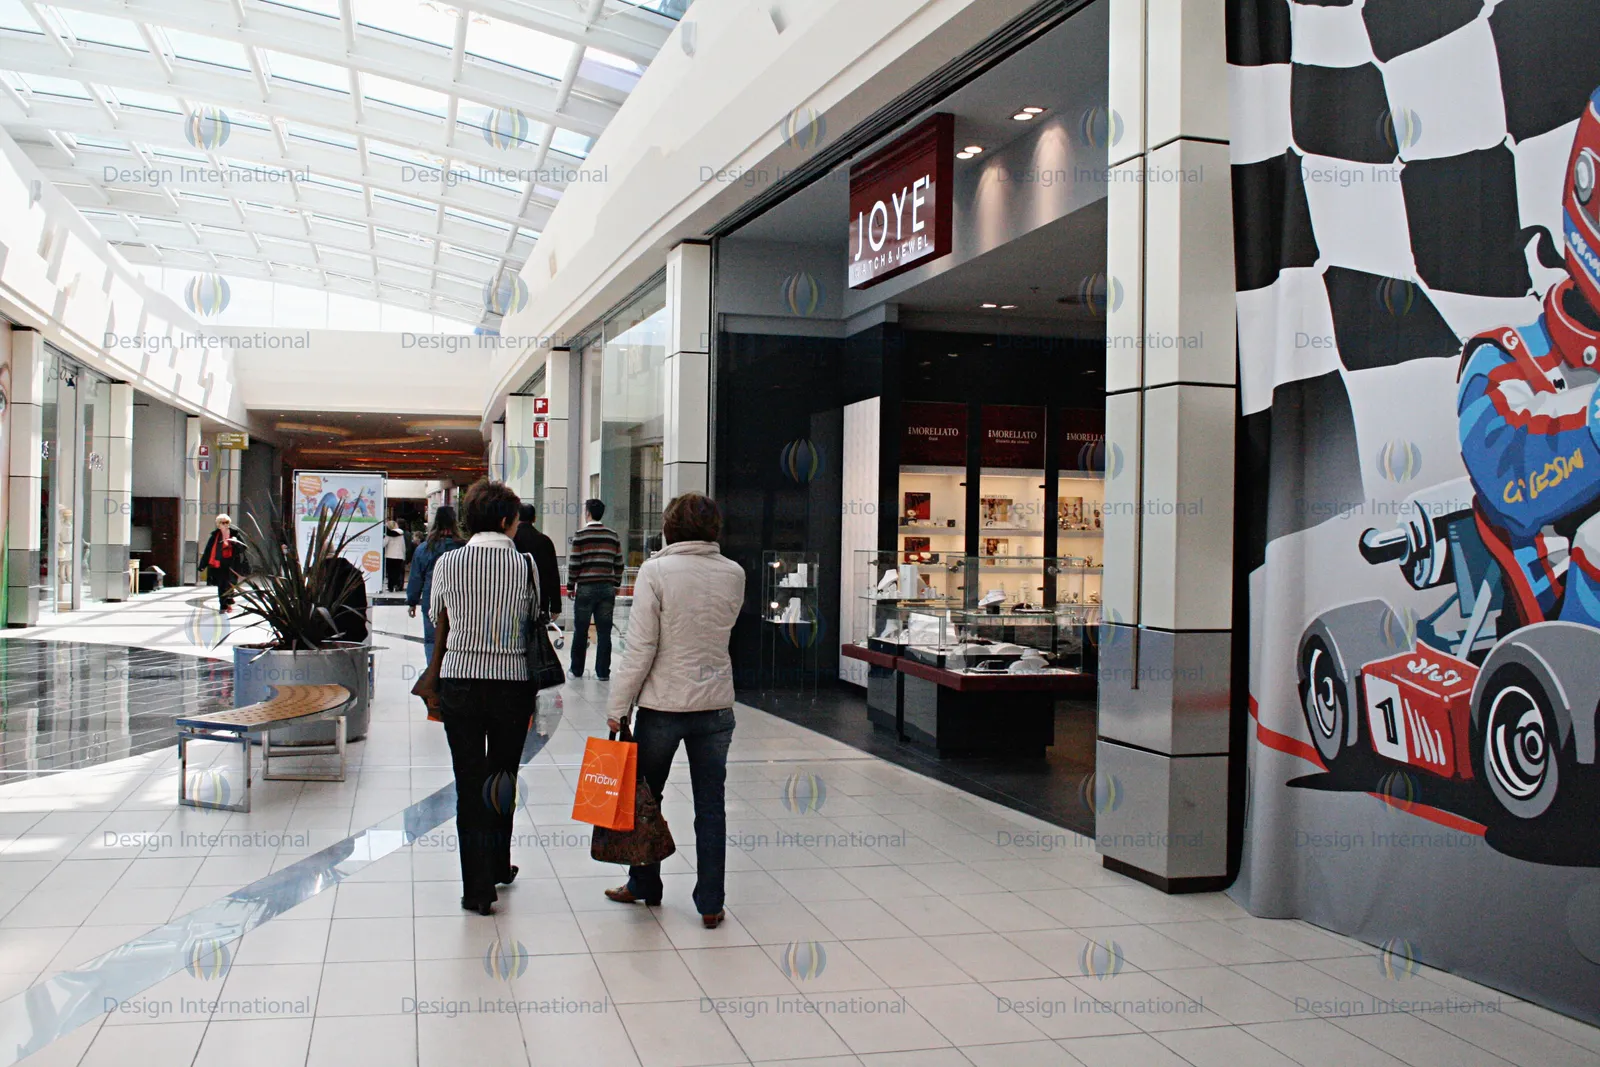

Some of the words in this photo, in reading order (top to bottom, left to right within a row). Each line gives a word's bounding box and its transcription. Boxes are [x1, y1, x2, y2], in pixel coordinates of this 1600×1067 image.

[911, 427, 959, 436] MORELLATO
[991, 430, 1038, 439] MORELLATO
[1375, 697, 1399, 745] 1
